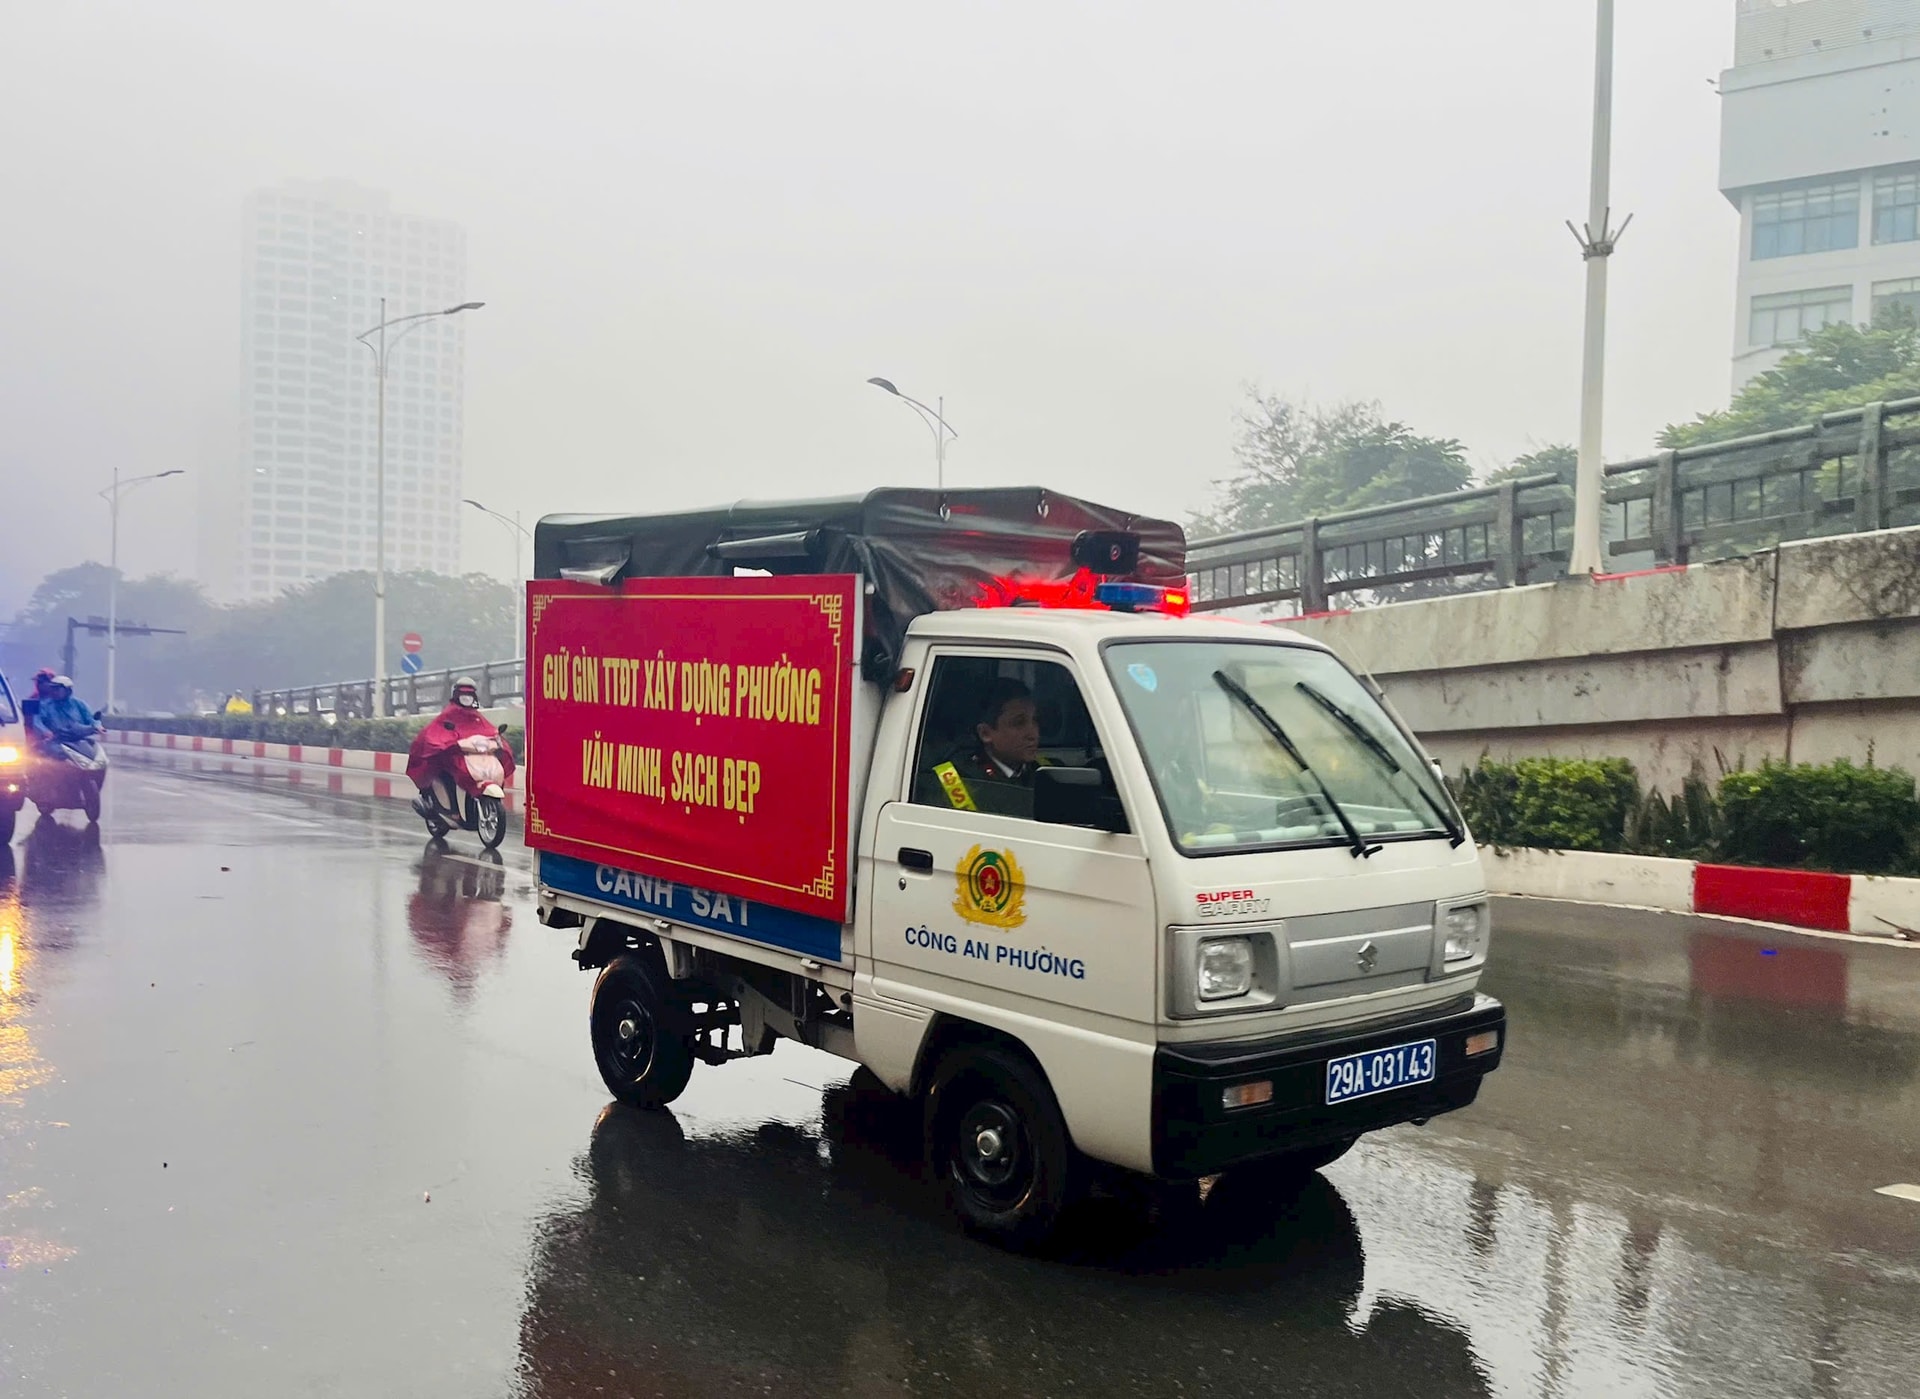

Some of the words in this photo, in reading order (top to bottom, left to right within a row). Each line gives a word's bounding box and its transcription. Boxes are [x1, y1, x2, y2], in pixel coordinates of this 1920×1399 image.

[543, 646, 570, 700] GIỮ
[572, 646, 599, 704] GÌN
[602, 657, 640, 707] TTĐT
[643, 649, 676, 711] XÂY
[681, 658, 730, 726] DỰNG
[735, 653, 822, 725] PHƯỜNG
[582, 730, 614, 789] VĂN
[617, 743, 666, 805] MINH,
[671, 750, 718, 814] SẠCH
[723, 757, 761, 824] ĐẸP
[1196, 889, 1254, 903] SUPER
[1198, 898, 1271, 918] CARRY
[905, 924, 957, 954] CÔNG
[963, 939, 989, 961] AN
[996, 945, 1085, 980] PHƯỜNG
[1329, 1045, 1432, 1099] 29A-031.43
